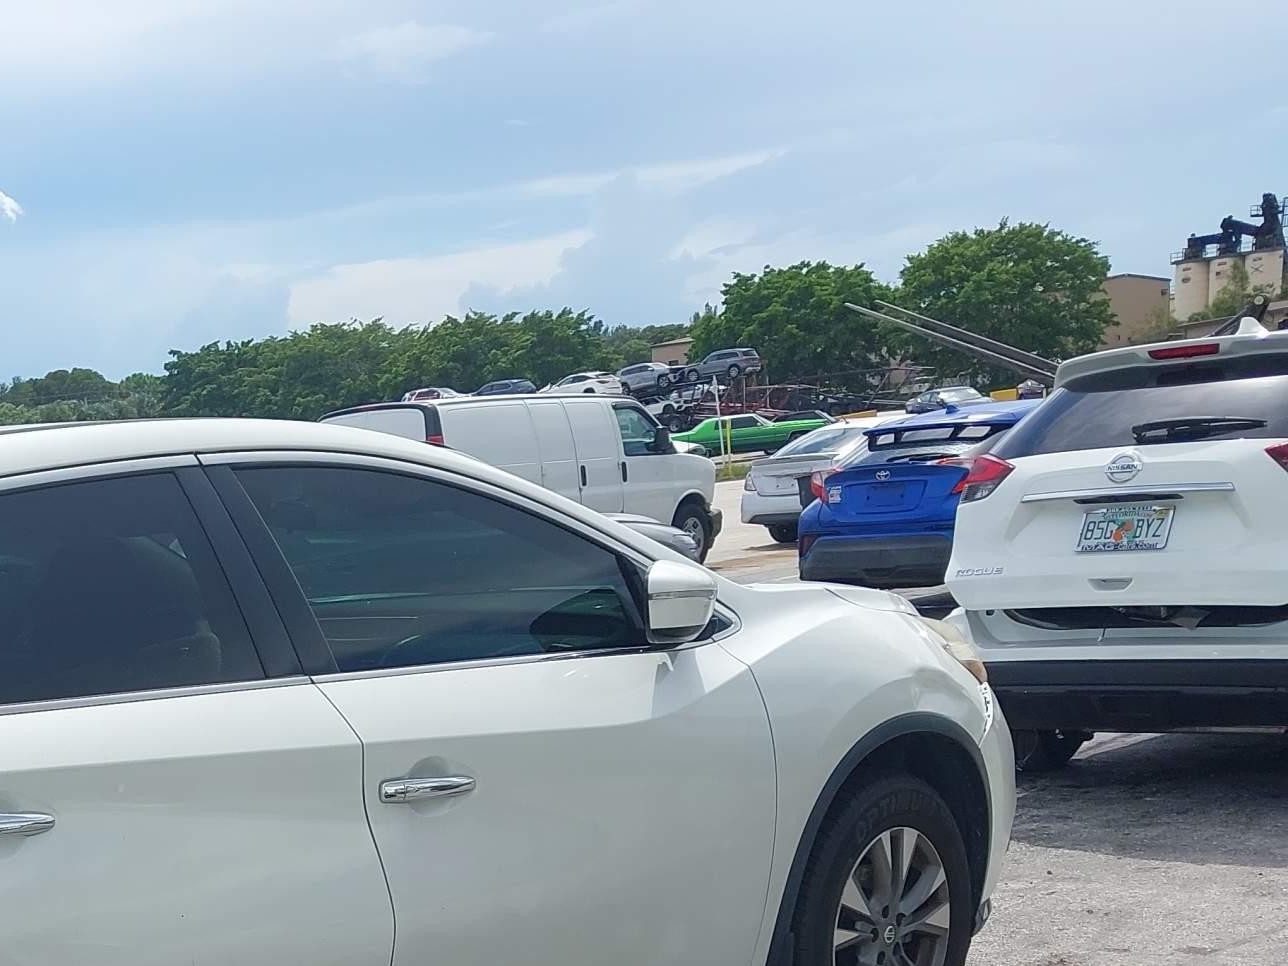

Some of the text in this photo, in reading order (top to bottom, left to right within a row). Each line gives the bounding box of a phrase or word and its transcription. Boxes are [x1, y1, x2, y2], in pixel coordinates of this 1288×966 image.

[1106, 463, 1138, 472] NISSAN
[1132, 518, 1165, 539] BYZ
[954, 566, 1004, 578] ROGUE
